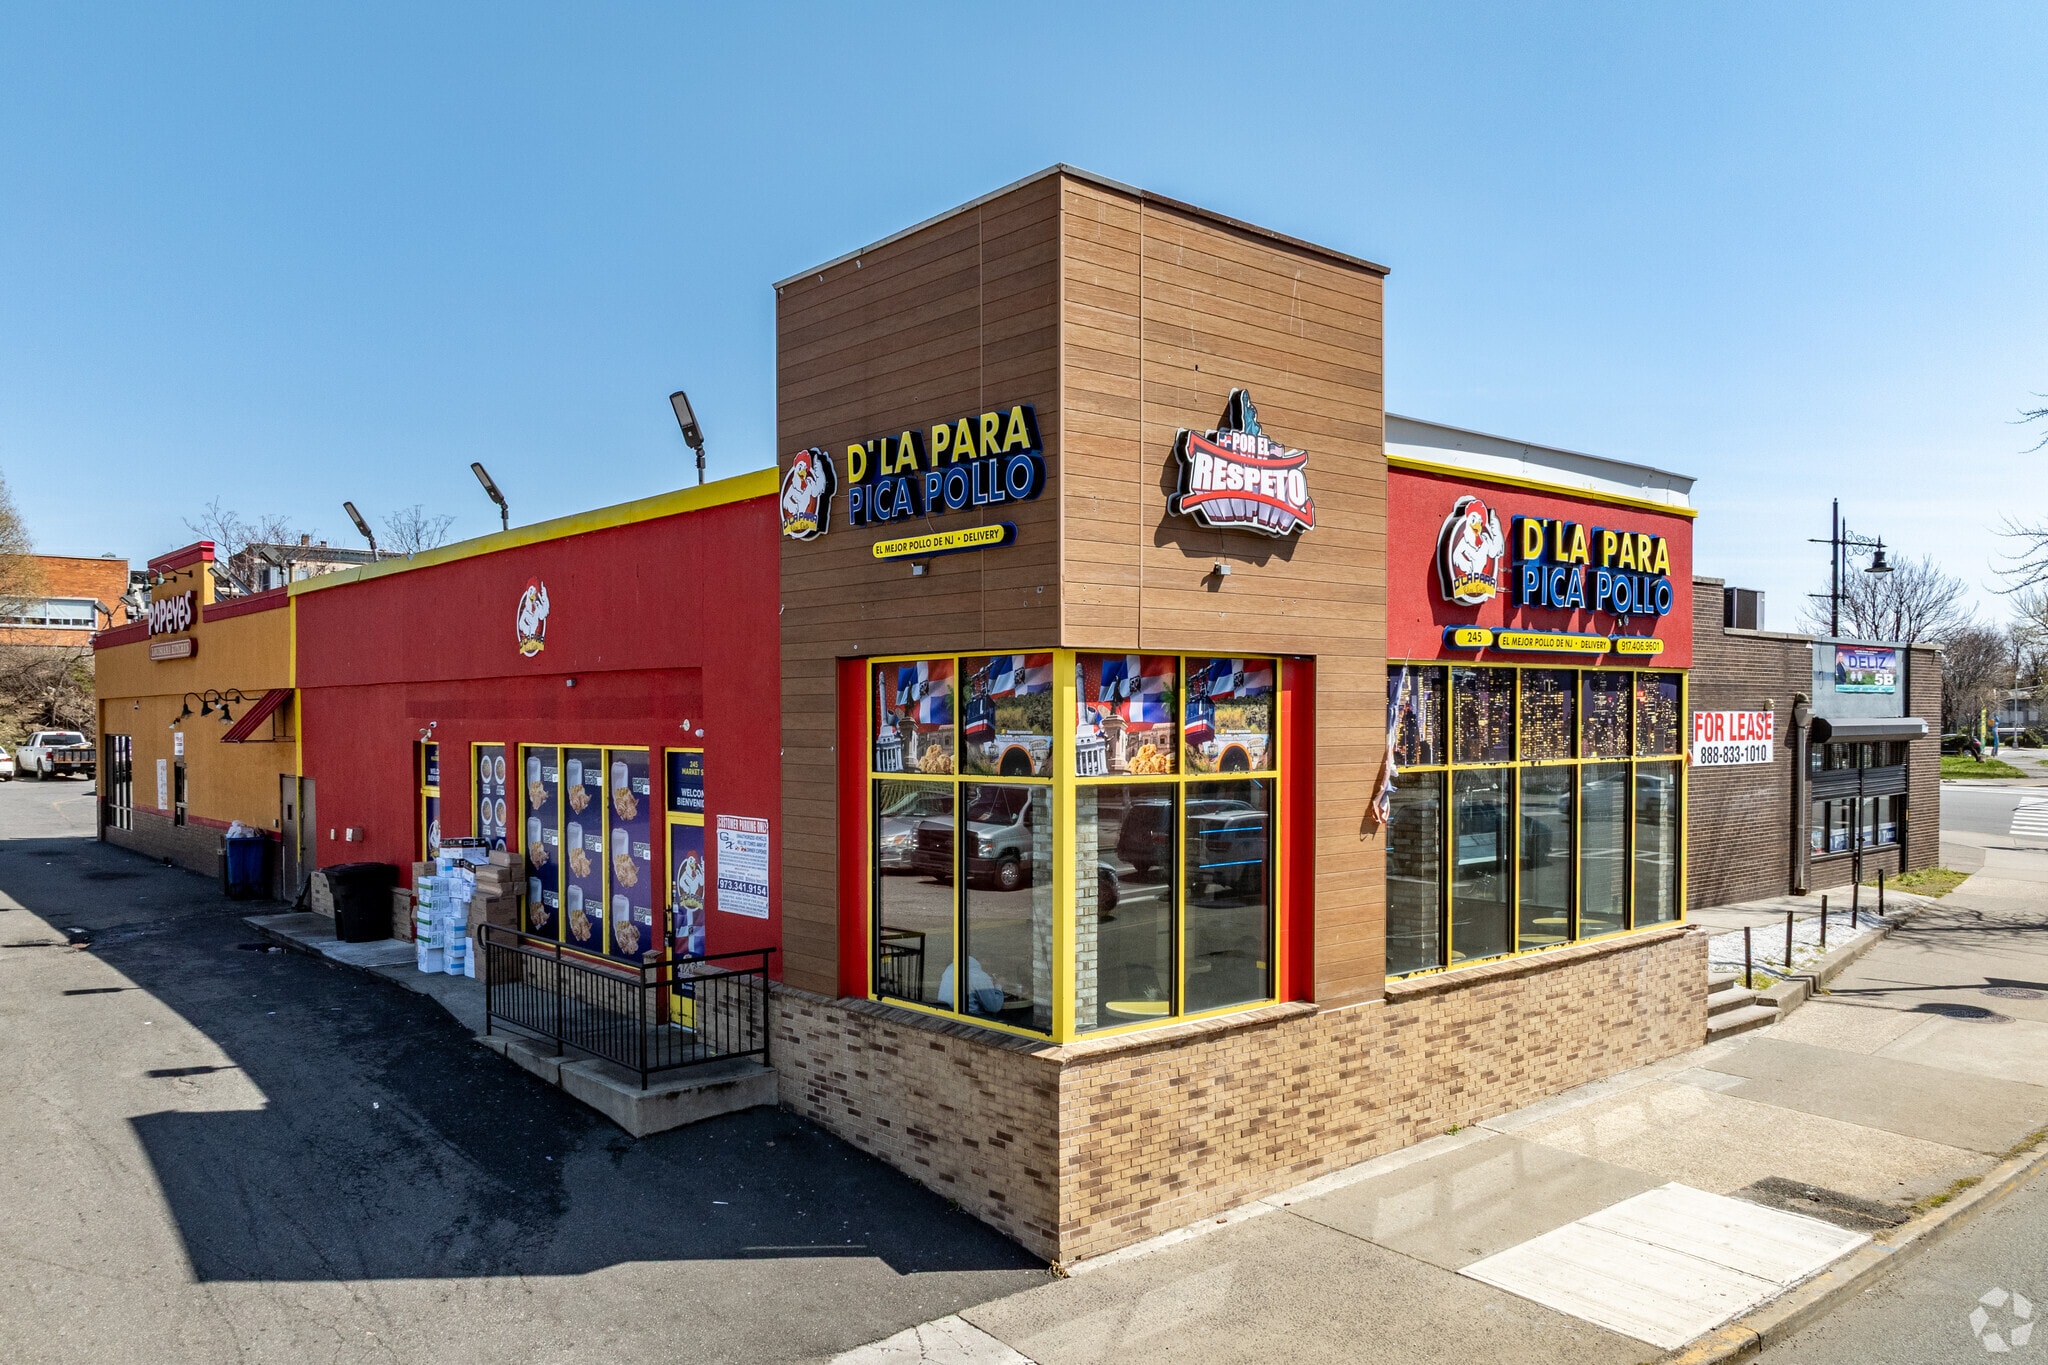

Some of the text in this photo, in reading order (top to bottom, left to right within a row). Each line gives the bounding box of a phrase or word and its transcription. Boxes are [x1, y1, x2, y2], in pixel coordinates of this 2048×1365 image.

[847, 405, 1031, 484] D'LA PARA
[1232, 432, 1270, 456] POR EL
[848, 454, 1035, 526] PICA POLLO
[1192, 452, 1306, 507] RESPETO
[875, 529, 1000, 554] EL MEJOR POLLO DE NJ DELIVERY
[1523, 518, 1671, 576] D'LA PARA
[1522, 564, 1674, 616] PICA POLLO
[1467, 631, 1482, 643] 245
[1502, 636, 1607, 650] EL MEJOR POLLO DE NJ DELIVERY
[1849, 655, 1887, 669] DELIZ
[1874, 673, 1894, 686] 5B
[1695, 712, 1772, 742] FOR LEASE
[719, 880, 766, 896] 973.341.9154
